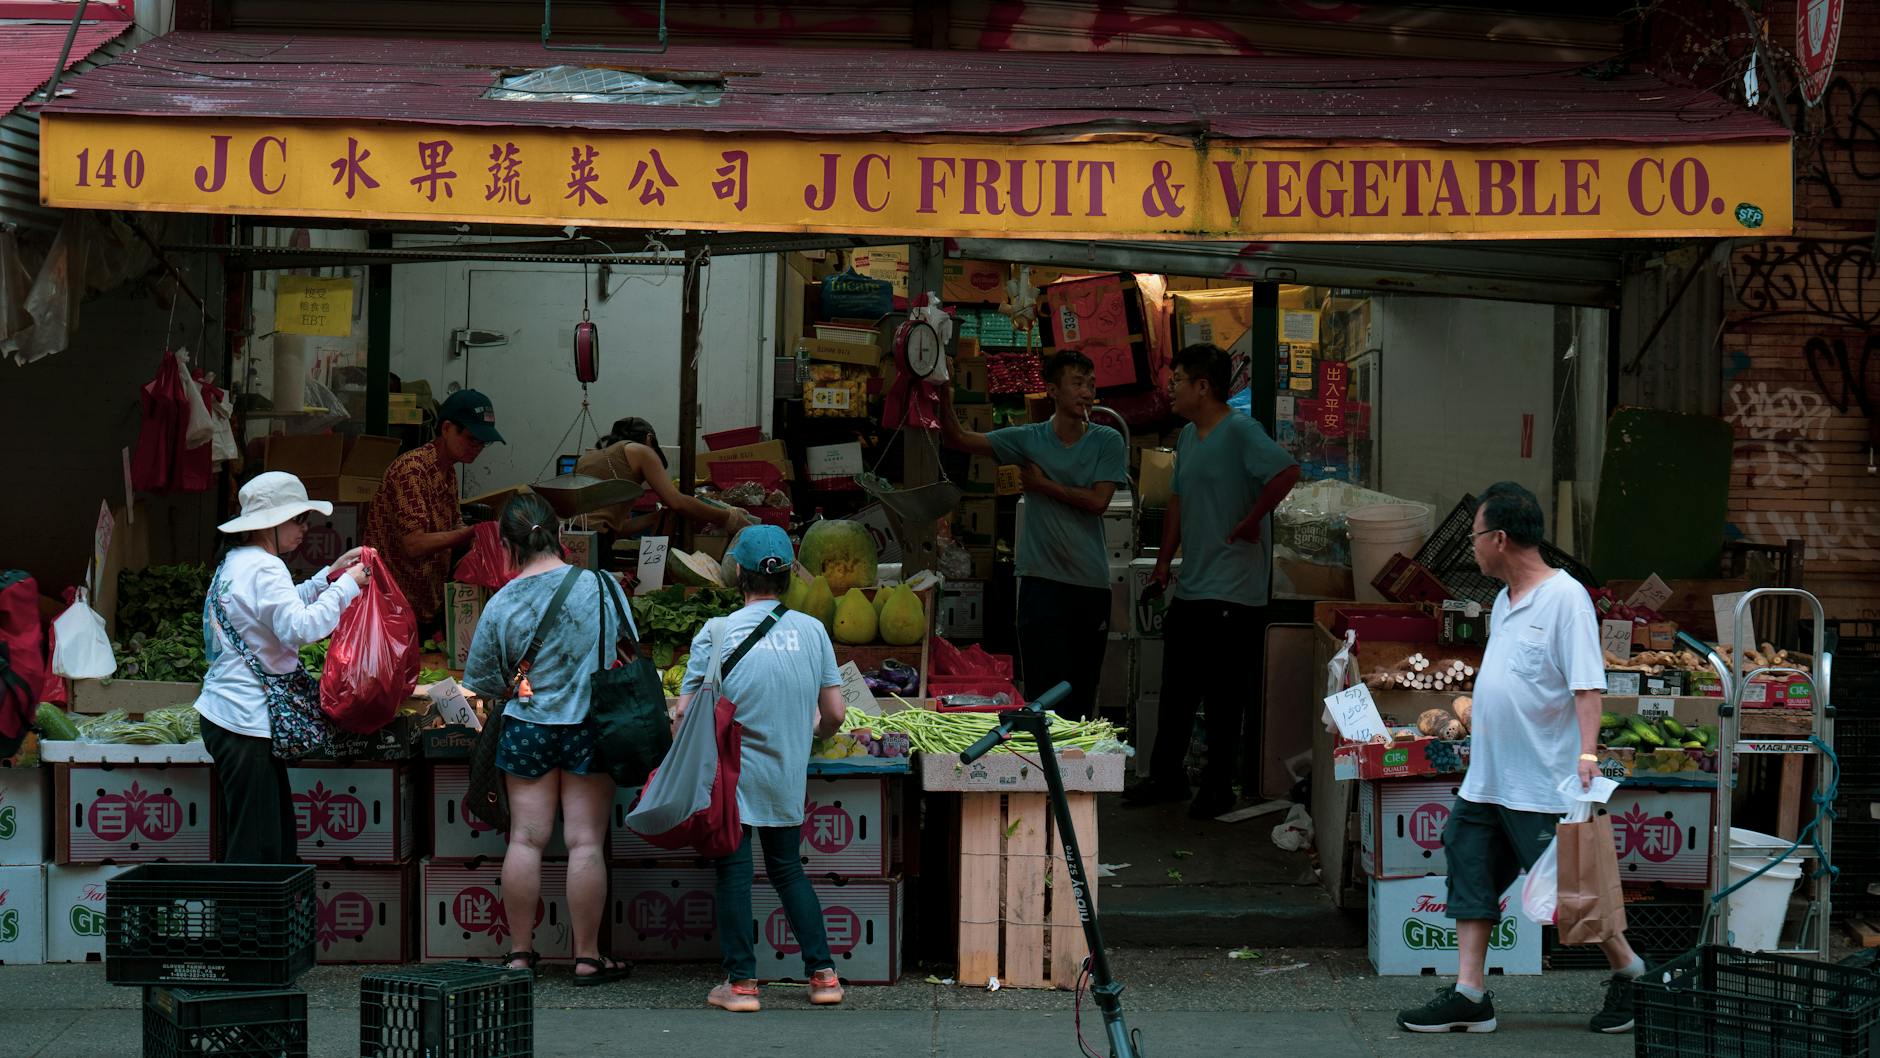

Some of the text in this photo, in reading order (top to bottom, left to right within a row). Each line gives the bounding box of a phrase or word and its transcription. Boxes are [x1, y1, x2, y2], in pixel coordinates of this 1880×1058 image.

[75, 148, 145, 188] 140
[194, 135, 749, 212] JC 水果蔬菜公司
[804, 153, 1725, 218] JC FRUIT & VEGETABLE CO.
[1738, 208, 1763, 223] STP
[302, 315, 327, 327] EBT
[1324, 367, 1341, 428] 出入平安
[1294, 524, 1328, 538] Poland
[1294, 533, 1329, 547] Spring
[1755, 744, 1809, 752] MAGLINER
[1383, 765, 1409, 774] QUALITY
[96, 801, 176, 834] 百利
